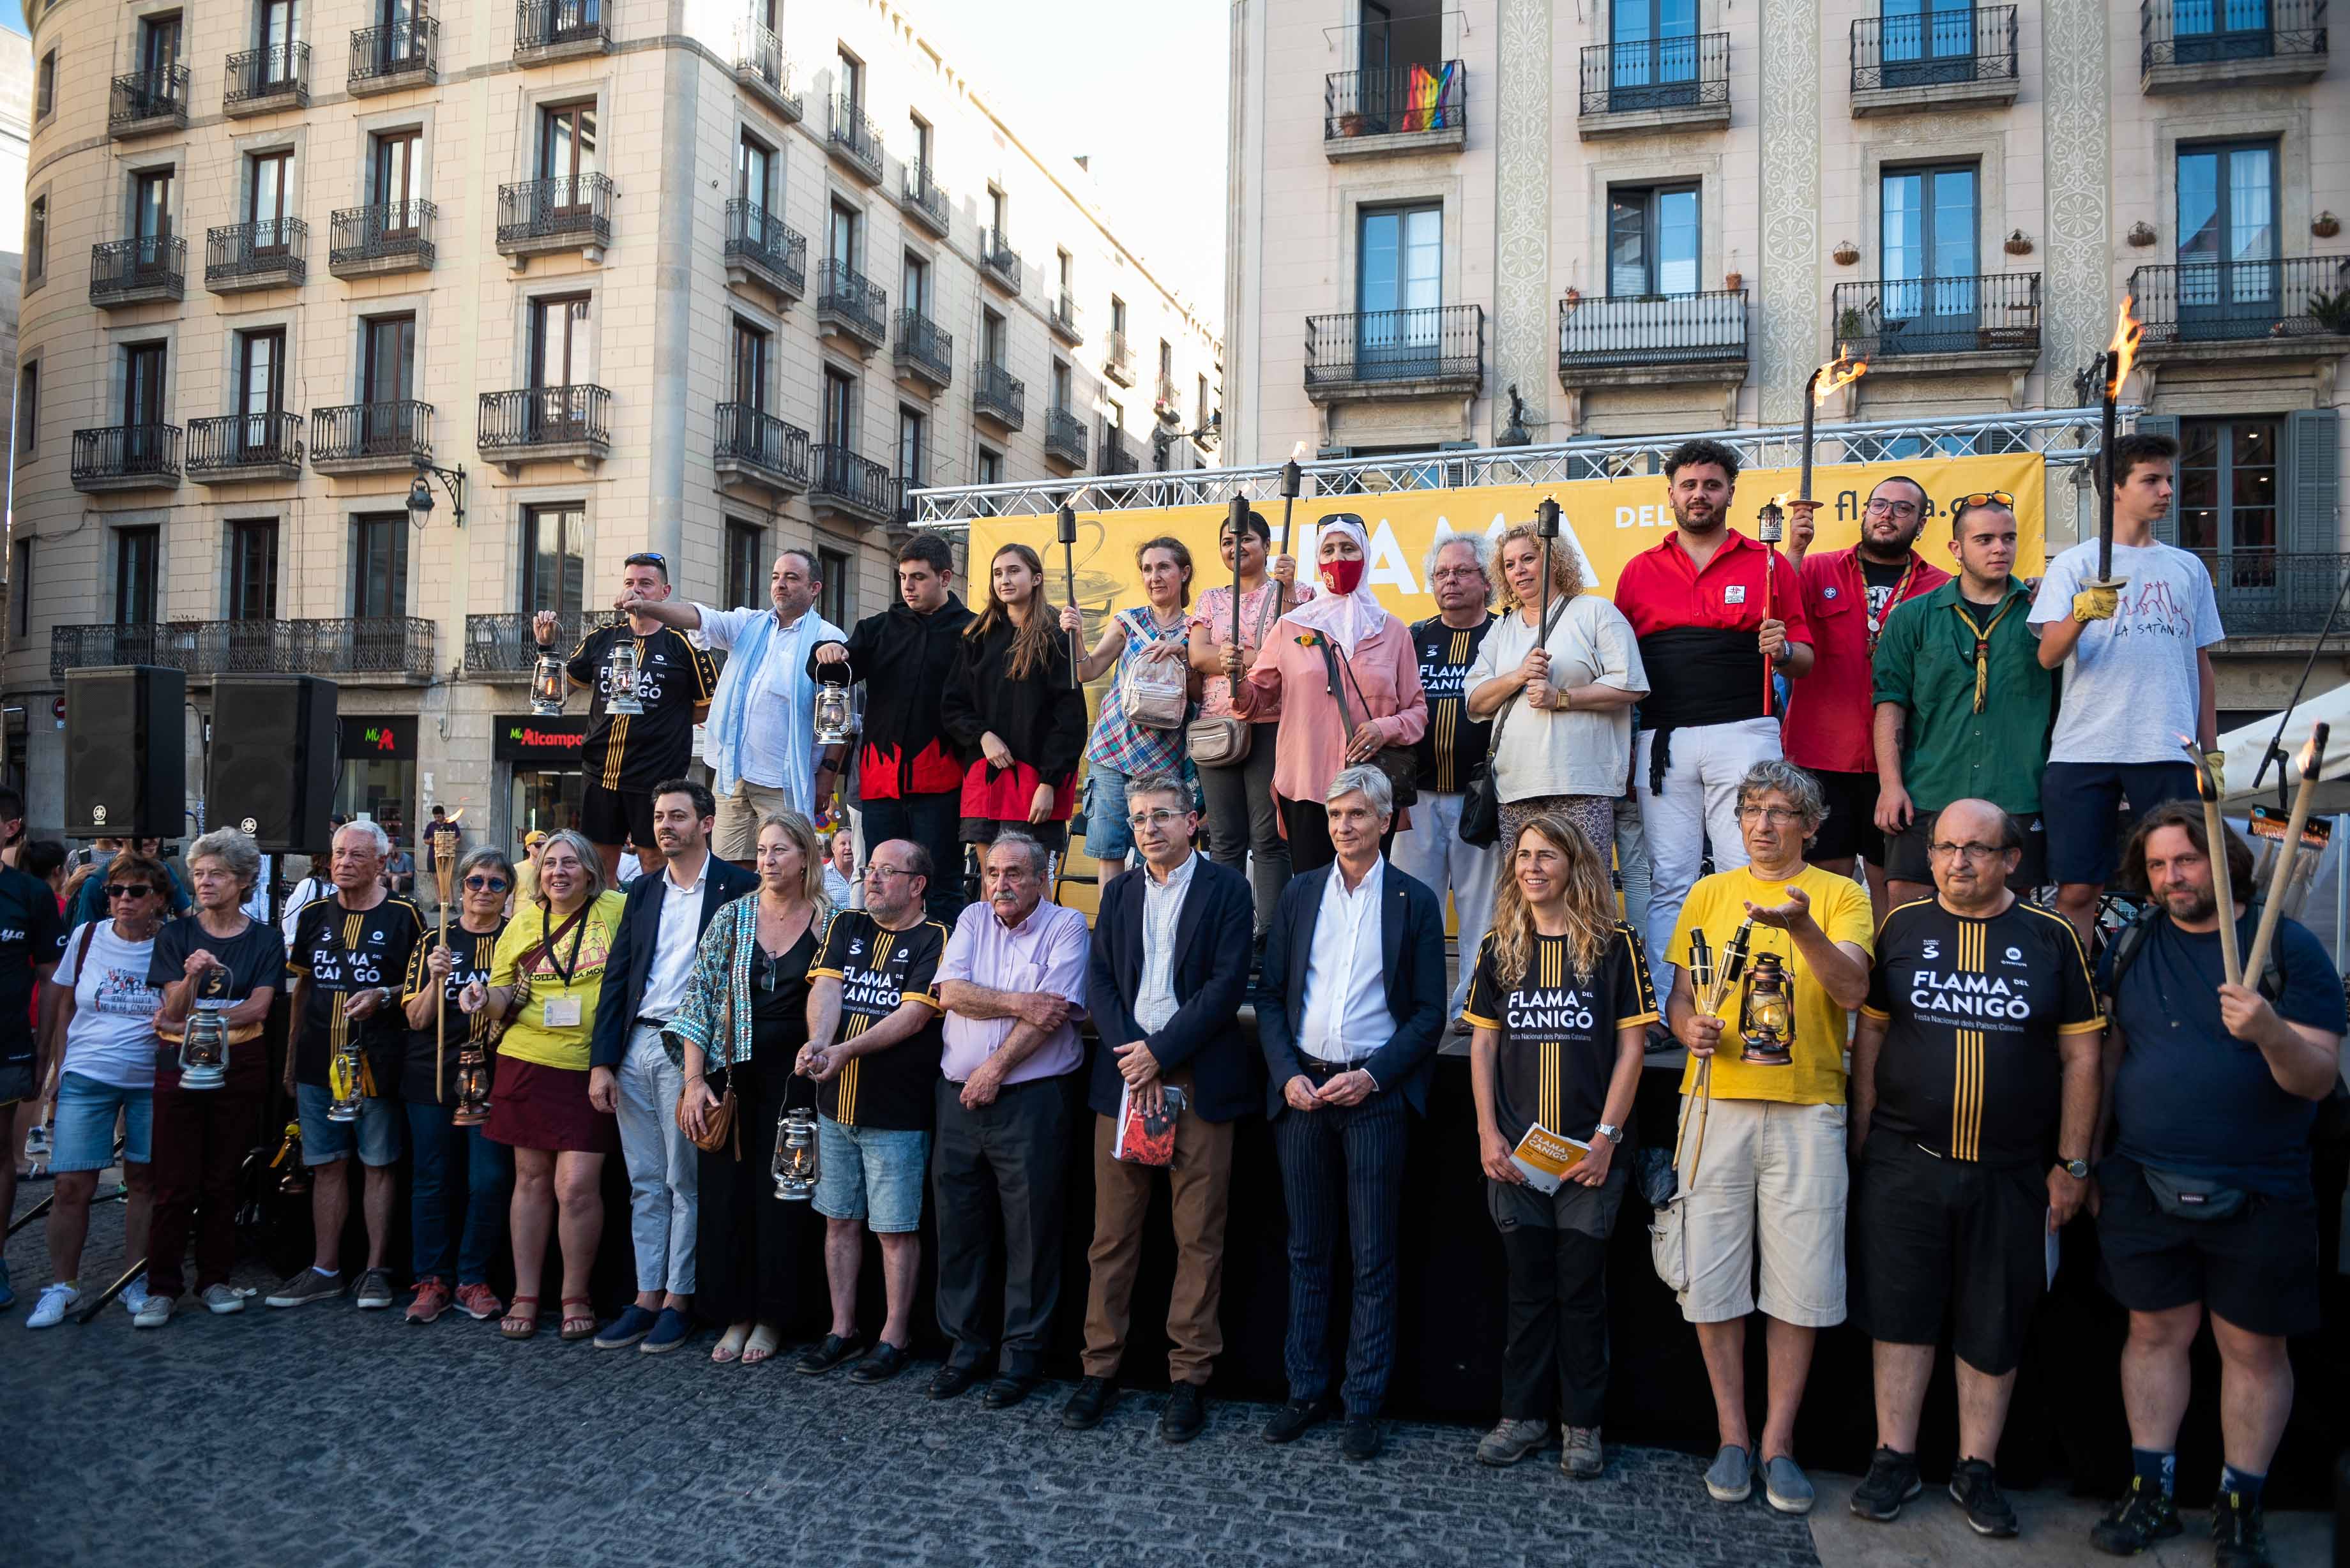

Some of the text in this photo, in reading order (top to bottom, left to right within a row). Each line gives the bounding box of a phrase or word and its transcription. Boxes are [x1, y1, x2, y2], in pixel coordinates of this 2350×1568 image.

[1615, 505, 1672, 529] DEL
[2114, 624, 2128, 637] LA
[1418, 665, 1466, 677] FLAM
[600, 681, 662, 699] CGÓ
[510, 727, 523, 739] Mi
[314, 965, 380, 982] CAGÓ
[843, 965, 892, 988] FLAMA
[1913, 970, 2029, 996] FLAMA DEL
[1508, 990, 1580, 1009] FLAMA
[1910, 990, 2031, 1020] CANIGÓ
[1507, 1006, 1593, 1029] CANIGÓ
[1914, 1012, 1930, 1021] Festa
[1930, 1014, 1960, 1026] Nacional
[1528, 1139, 1569, 1161] CANIGÓ
[1532, 1133, 1566, 1154] FLAMA
